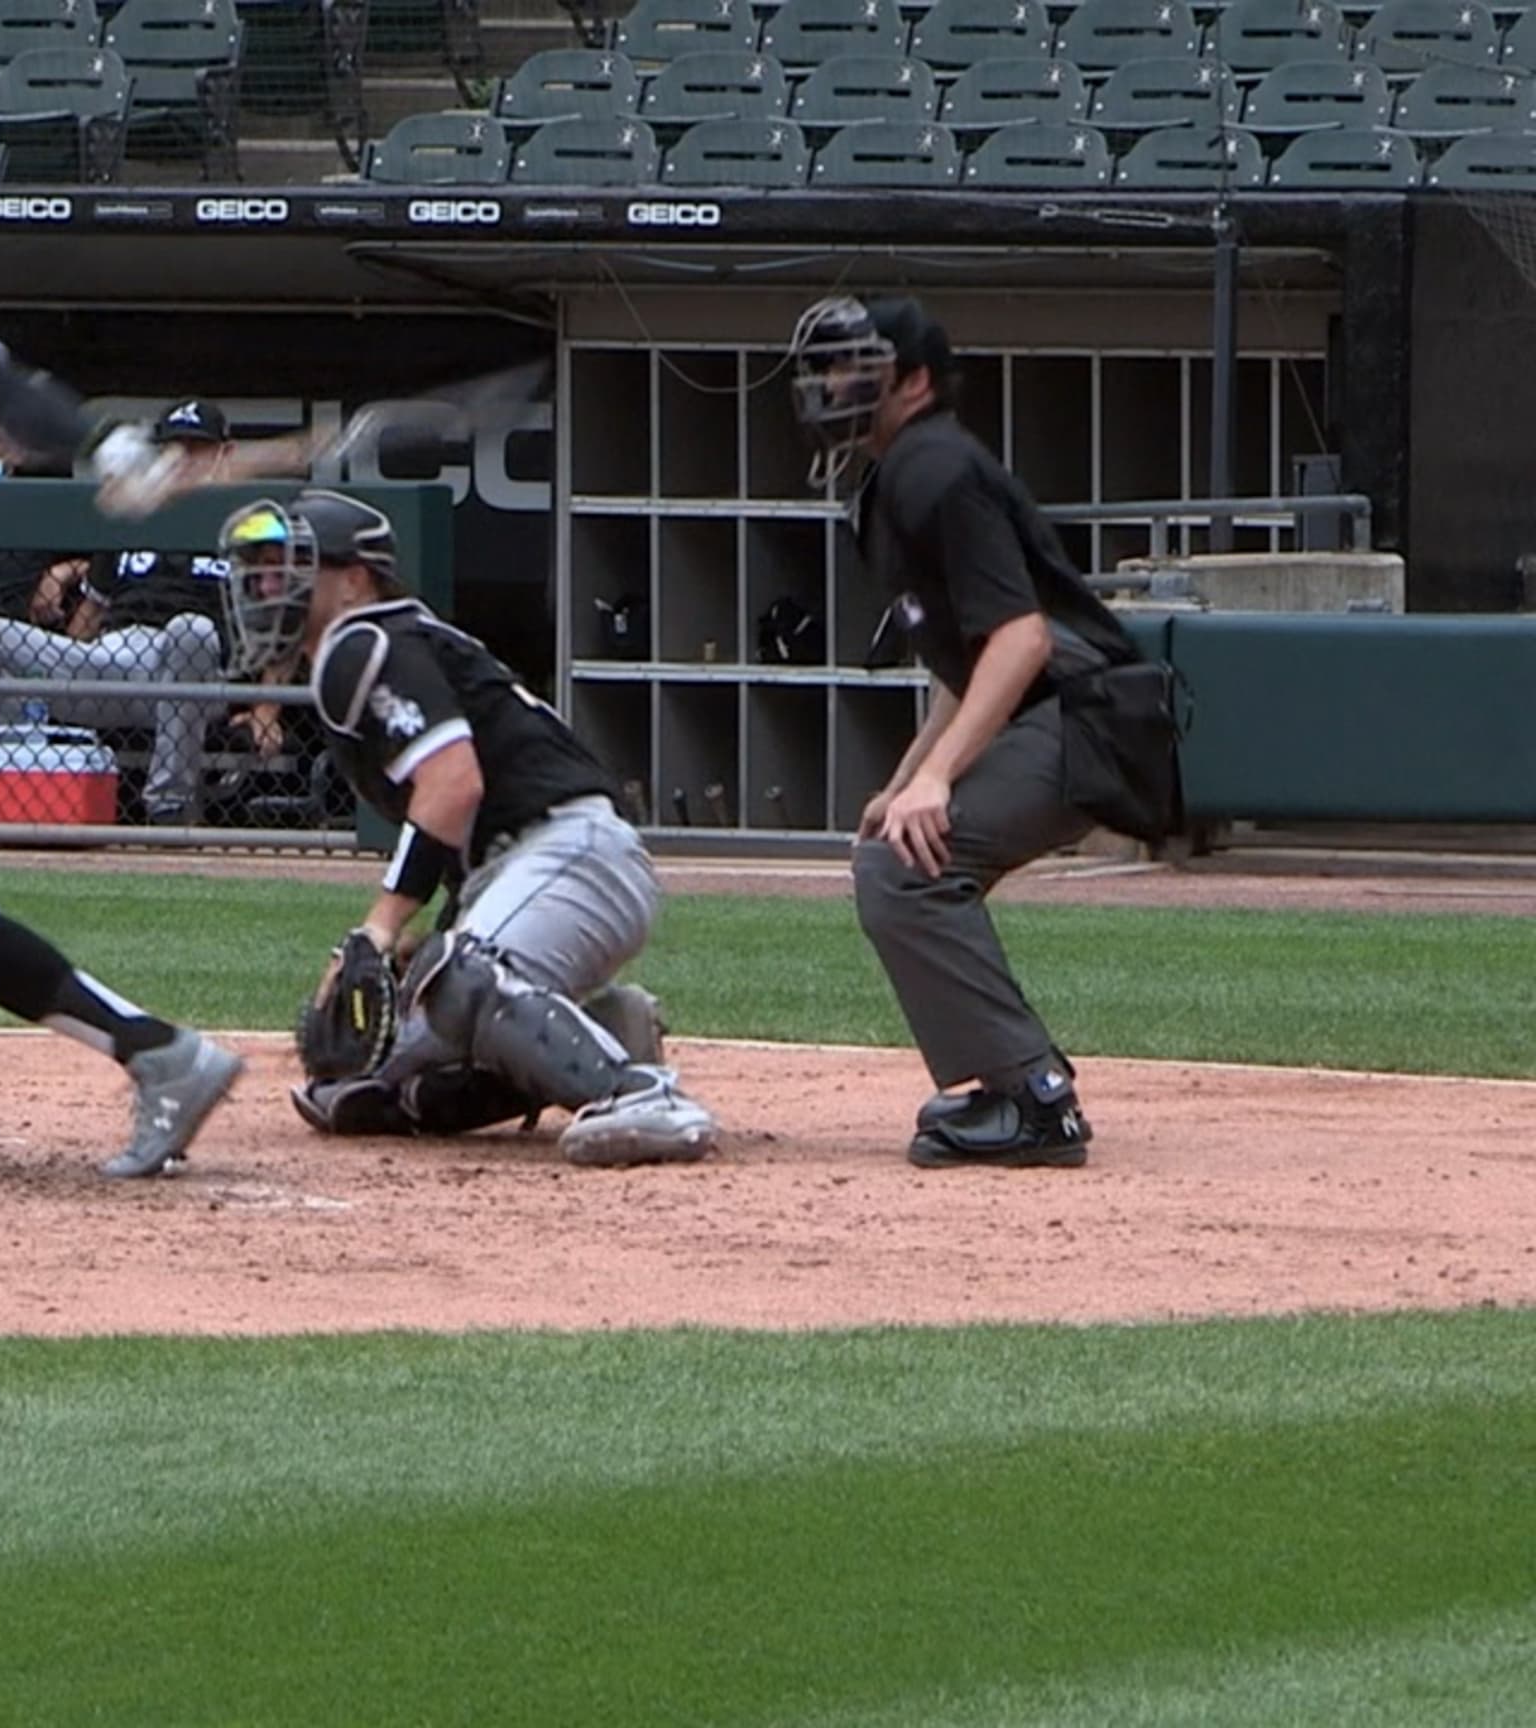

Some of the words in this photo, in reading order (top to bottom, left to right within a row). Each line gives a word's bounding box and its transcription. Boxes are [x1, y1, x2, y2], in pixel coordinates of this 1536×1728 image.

[196, 199, 288, 220] GEICO
[409, 201, 500, 222] GEICO
[627, 203, 720, 225] GEICO
